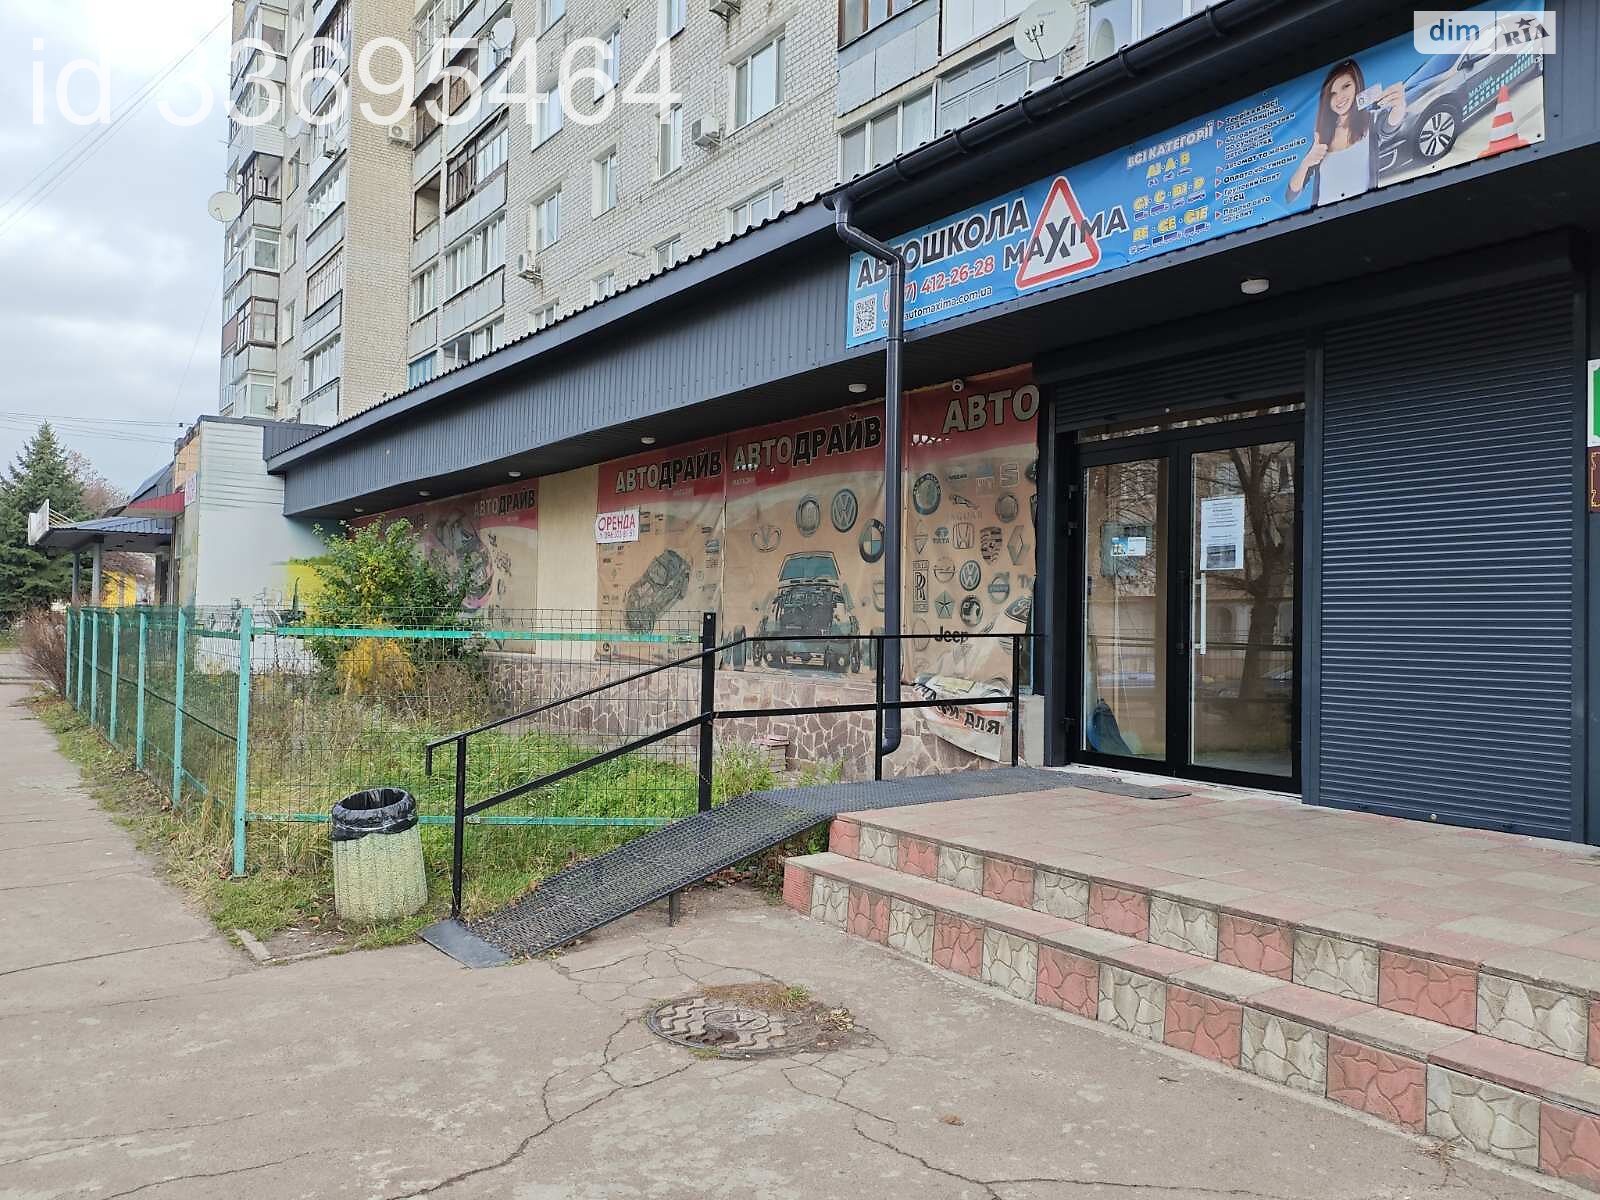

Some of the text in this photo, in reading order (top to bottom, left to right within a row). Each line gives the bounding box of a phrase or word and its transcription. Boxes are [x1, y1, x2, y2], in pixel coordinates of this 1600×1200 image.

[1149, 120, 1214, 158] КАТЕГОРІЇ
[1004, 206, 1127, 269] MAXIMA
[920, 256, 995, 294] 412-26-28
[942, 384, 1040, 434] АВТО
[733, 415, 882, 472] АВТОДРАЙВ
[616, 448, 722, 494] АВТОДРАЙВ
[474, 487, 536, 518] АВТОДРАЙВ
[598, 513, 636, 531] ОРЕНДА
[934, 625, 969, 643] Jeep
[964, 711, 1000, 735] ДЛЯ
